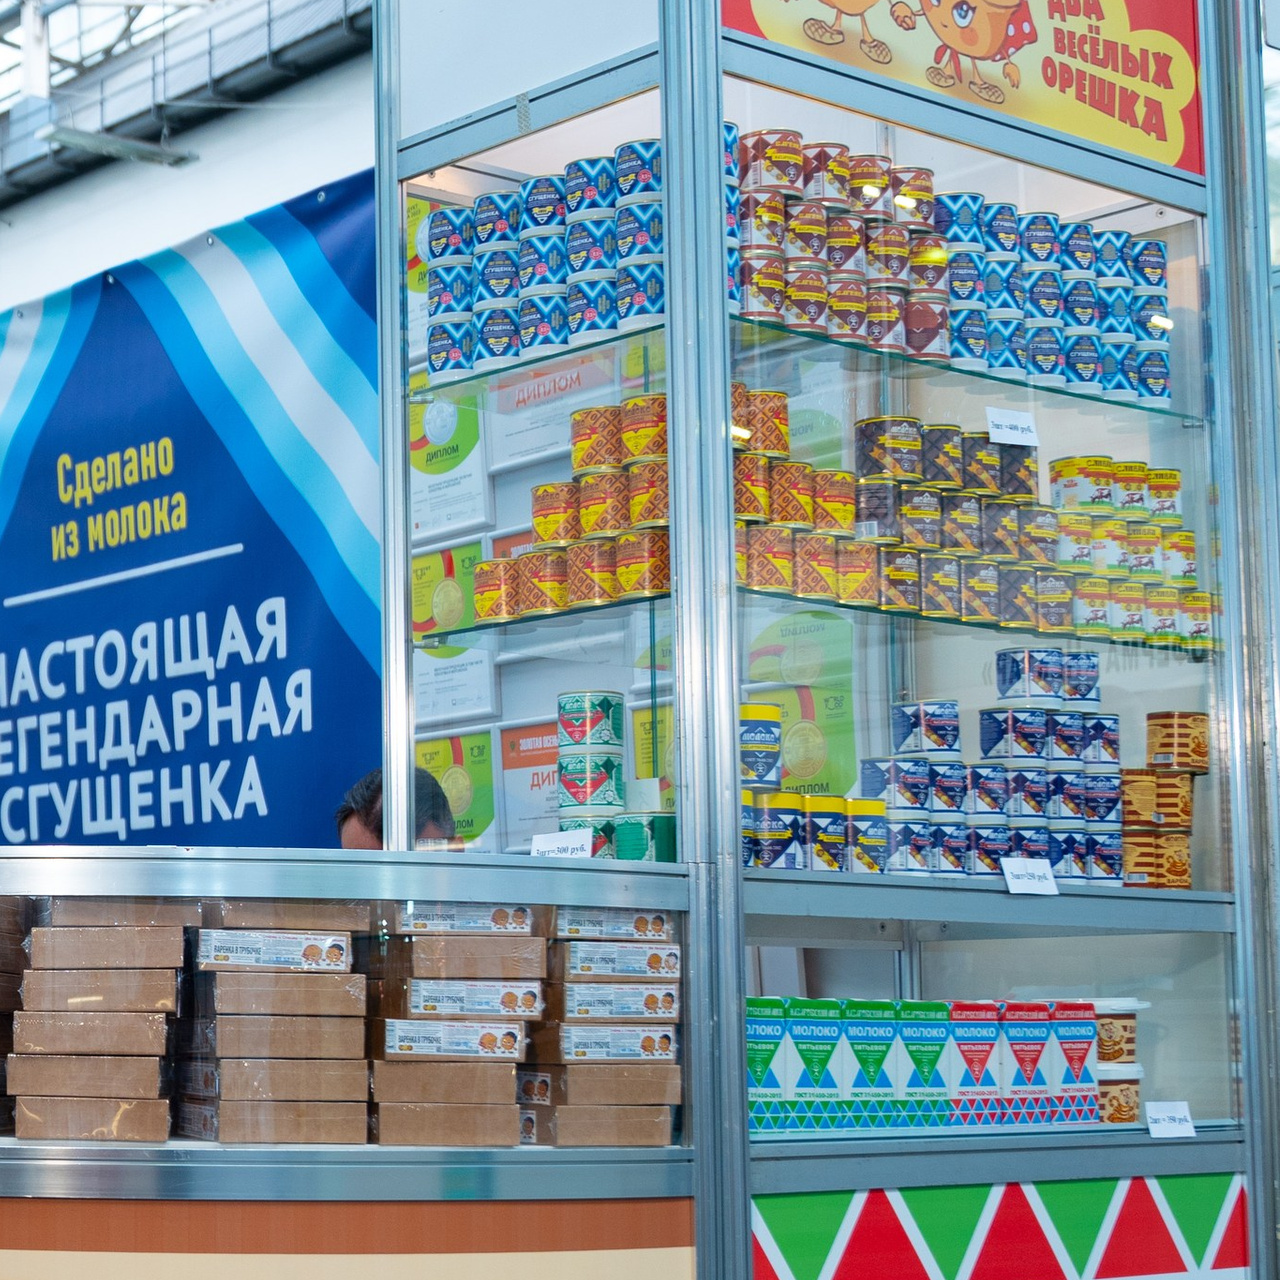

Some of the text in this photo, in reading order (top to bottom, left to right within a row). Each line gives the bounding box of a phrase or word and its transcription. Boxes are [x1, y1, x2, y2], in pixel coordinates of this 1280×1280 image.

[1054, 24, 1174, 90] ВЕСЁЛЫХ
[1042, 63, 1168, 142] ОРЕШКА
[516, 372, 581, 407] ДИПЛОМ
[426, 444, 459, 463] ДИПЛОМ
[57, 435, 174, 509] Сделано
[51, 490, 188, 562] из молока
[792, 1025, 838, 1037] МОЛОКО
[847, 1025, 893, 1037] МОЛОКО
[902, 1026, 946, 1038] МОЛОКО
[954, 1027, 996, 1038] МОЛОКО
[1009, 1028, 1047, 1038] МОЛОКО
[1058, 1026, 1094, 1036] МОЛОКО
